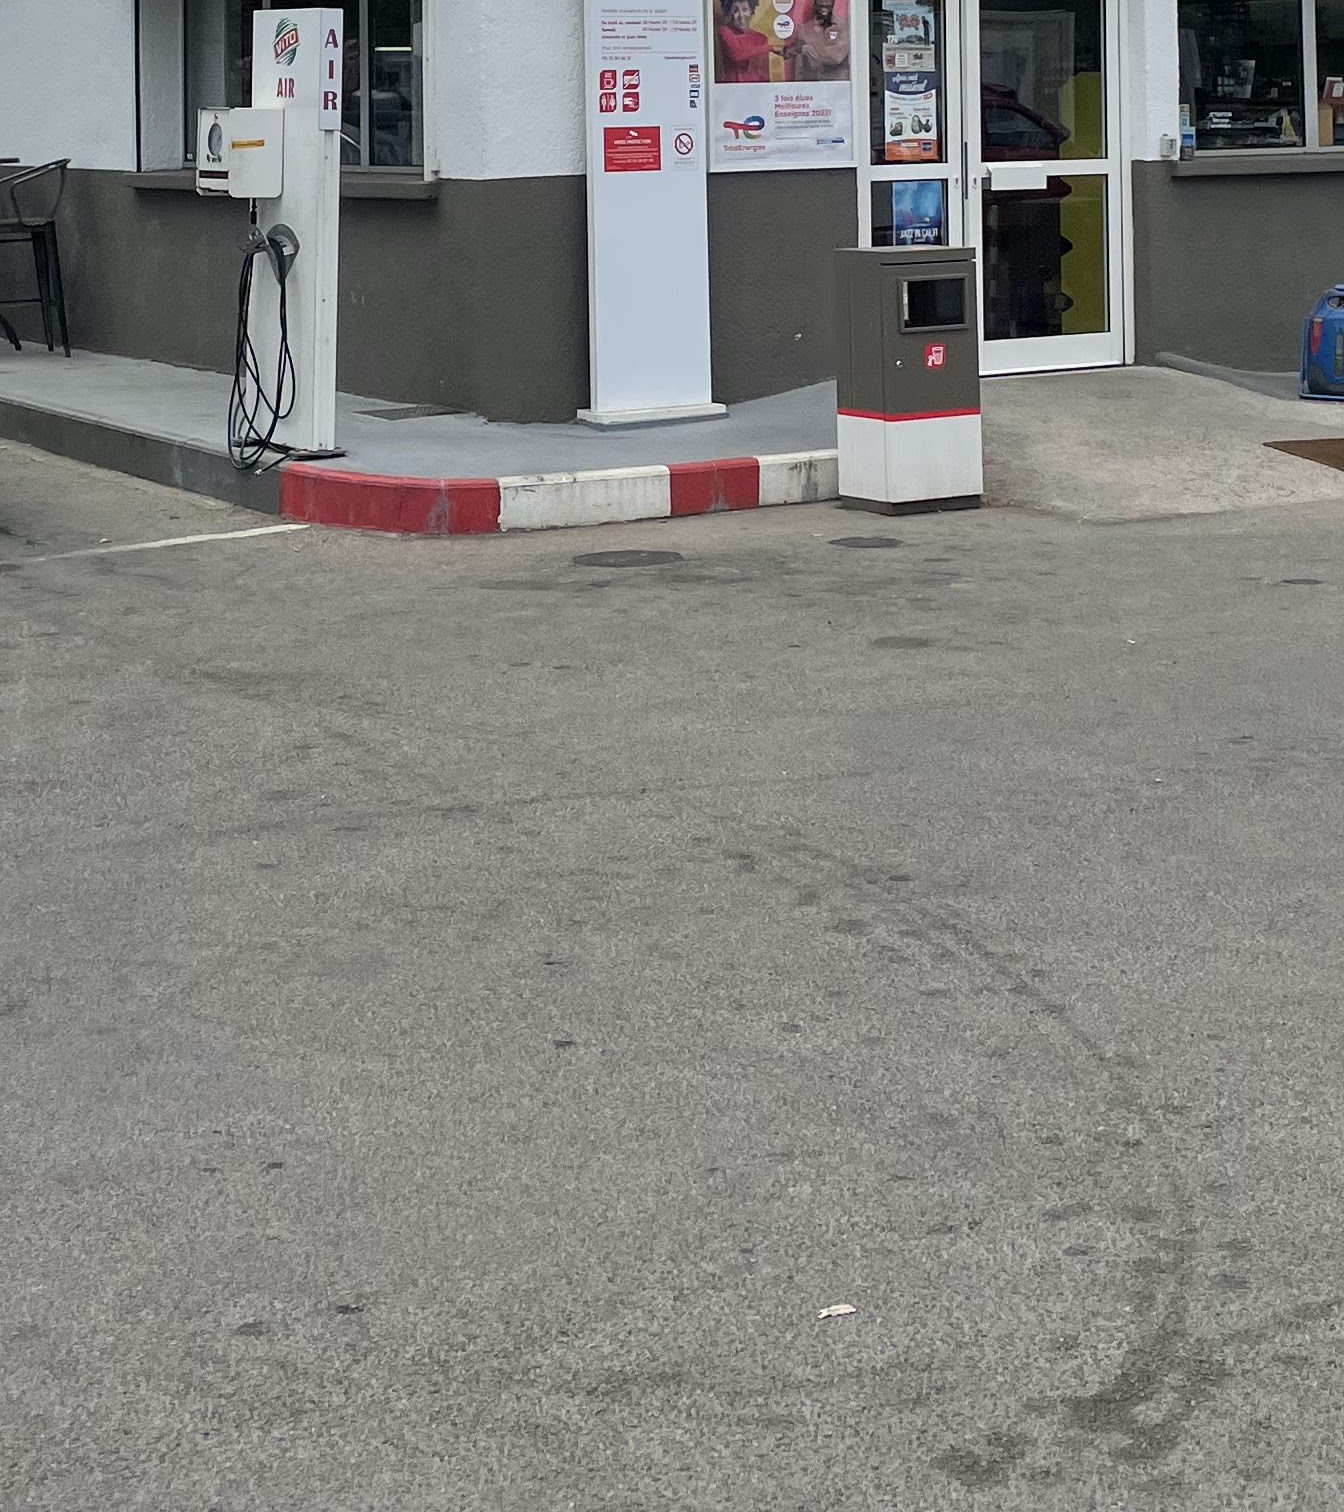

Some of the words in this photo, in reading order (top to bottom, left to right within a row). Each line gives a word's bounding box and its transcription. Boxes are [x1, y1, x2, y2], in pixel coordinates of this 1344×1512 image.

[275, 29, 297, 55] VITO
[323, 28, 339, 110] AIR
[277, 77, 295, 98] AIR
